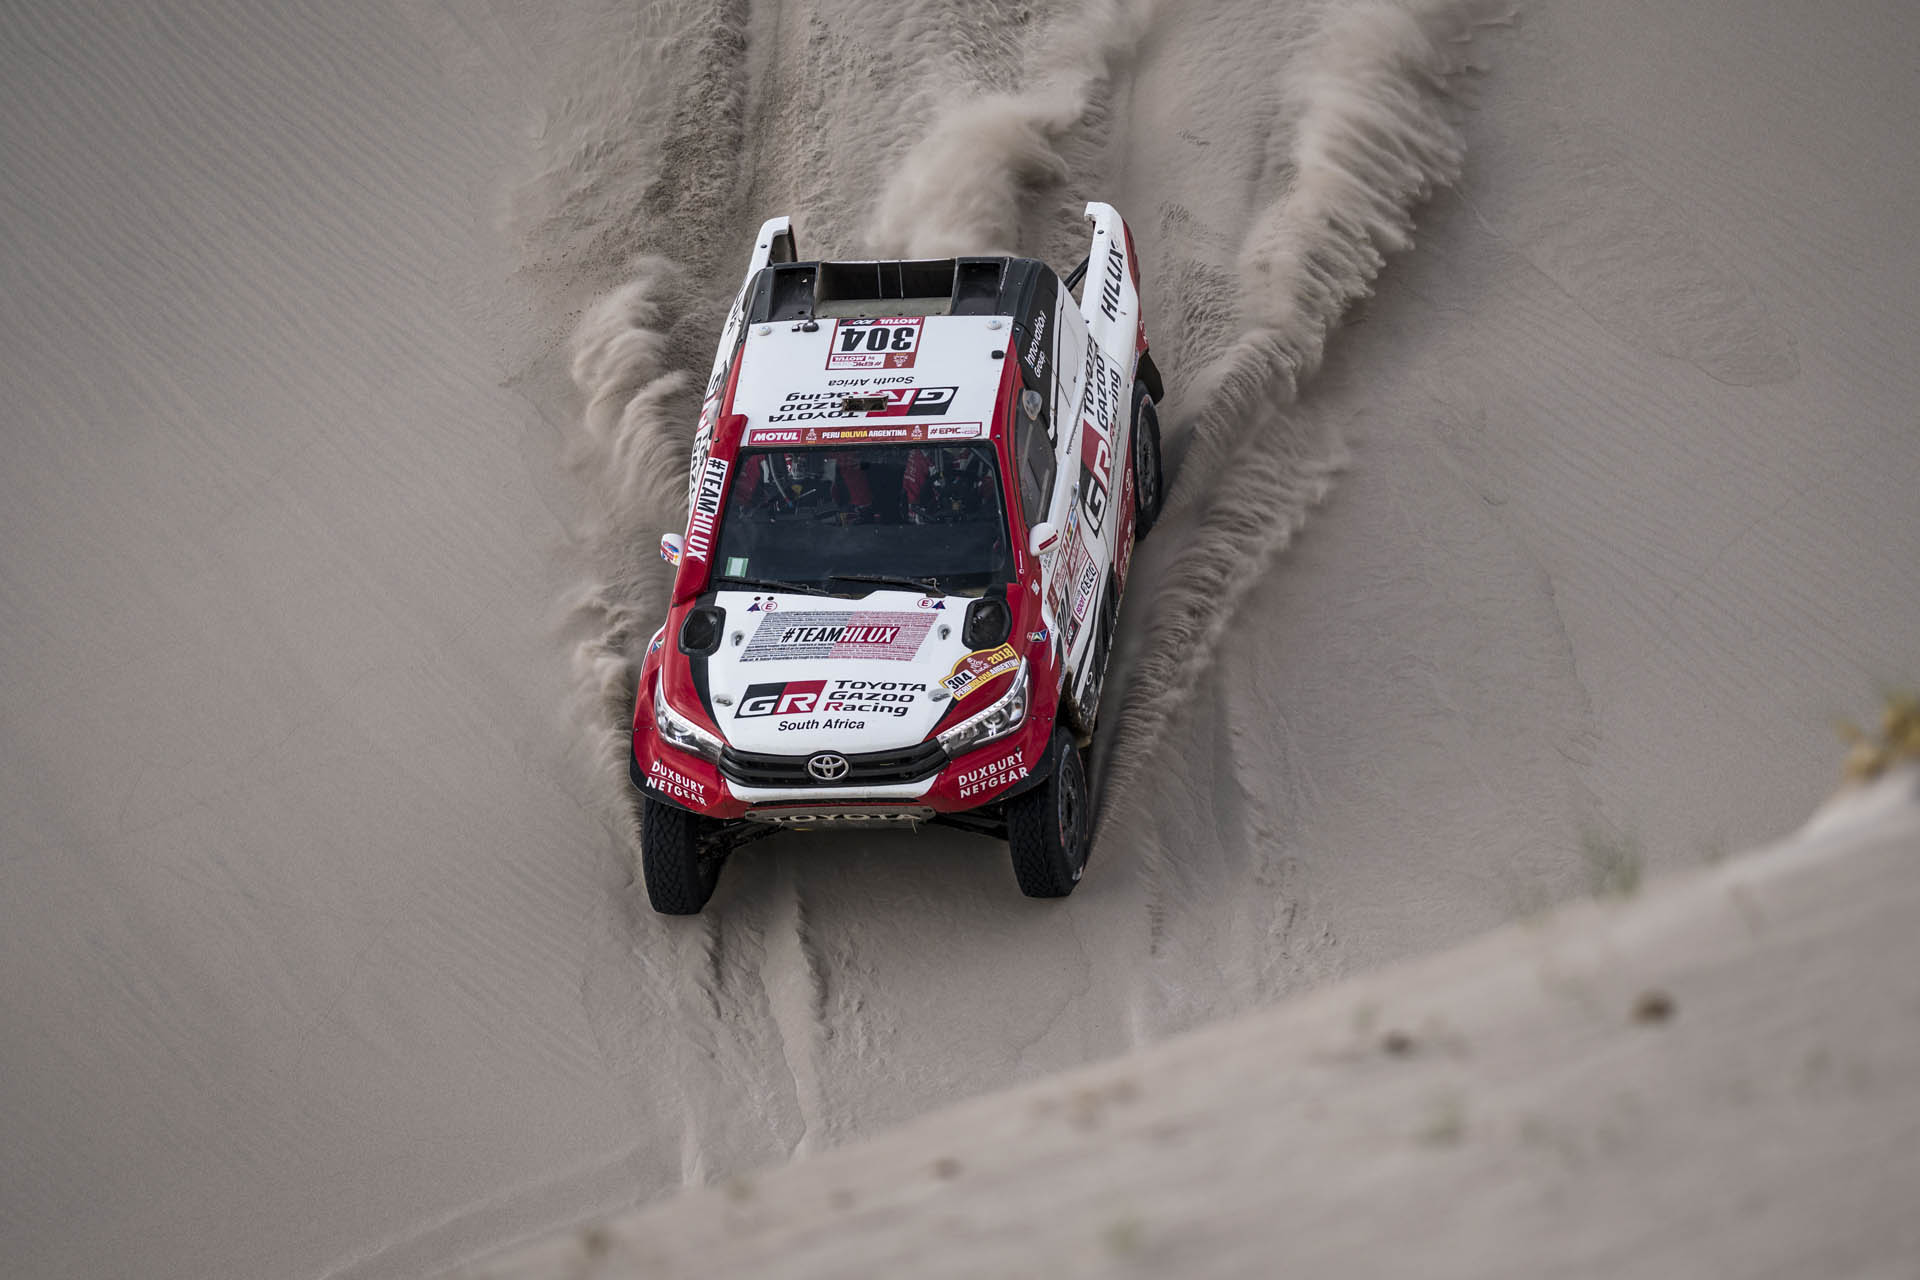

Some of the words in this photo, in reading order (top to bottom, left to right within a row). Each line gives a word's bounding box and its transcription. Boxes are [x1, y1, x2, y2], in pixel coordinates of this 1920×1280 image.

[1101, 240, 1123, 322] HILUX
[841, 327, 915, 351] 304
[1025, 310, 1047, 367] Innovation
[1034, 351, 1045, 378] Group
[828, 378, 870, 387] Africa
[873, 376, 915, 385] South
[1083, 332, 1099, 416] TOYOTA
[1096, 353, 1108, 431] GAZOO
[780, 401, 843, 411] AZOO
[768, 410, 859, 422] TOYOTA
[753, 431, 799, 441] MOTUL
[821, 431, 841, 439] PERU
[840, 430, 868, 438] BOLIVIA
[868, 429, 908, 437] ARGENTINA
[1084, 438, 1111, 533] GR
[686, 458, 726, 562] #TEAMHILUX
[781, 627, 898, 643] #TEAMHILUX
[987, 648, 1014, 665] 2018
[834, 680, 926, 691] TOYOTA
[948, 672, 972, 689] 304
[968, 671, 993, 688] BOLIVIA
[738, 691, 820, 717] GR
[828, 691, 915, 702] GAZOO
[823, 702, 909, 717] Racing
[777, 718, 819, 731] South
[823, 718, 865, 730] Africa
[651, 760, 705, 794] DUXBURY
[958, 751, 1023, 786] DUXBURY
[645, 776, 708, 806] NETGEAR
[960, 767, 1029, 799] NETGEAR
[765, 814, 921, 823] TOYOTA
